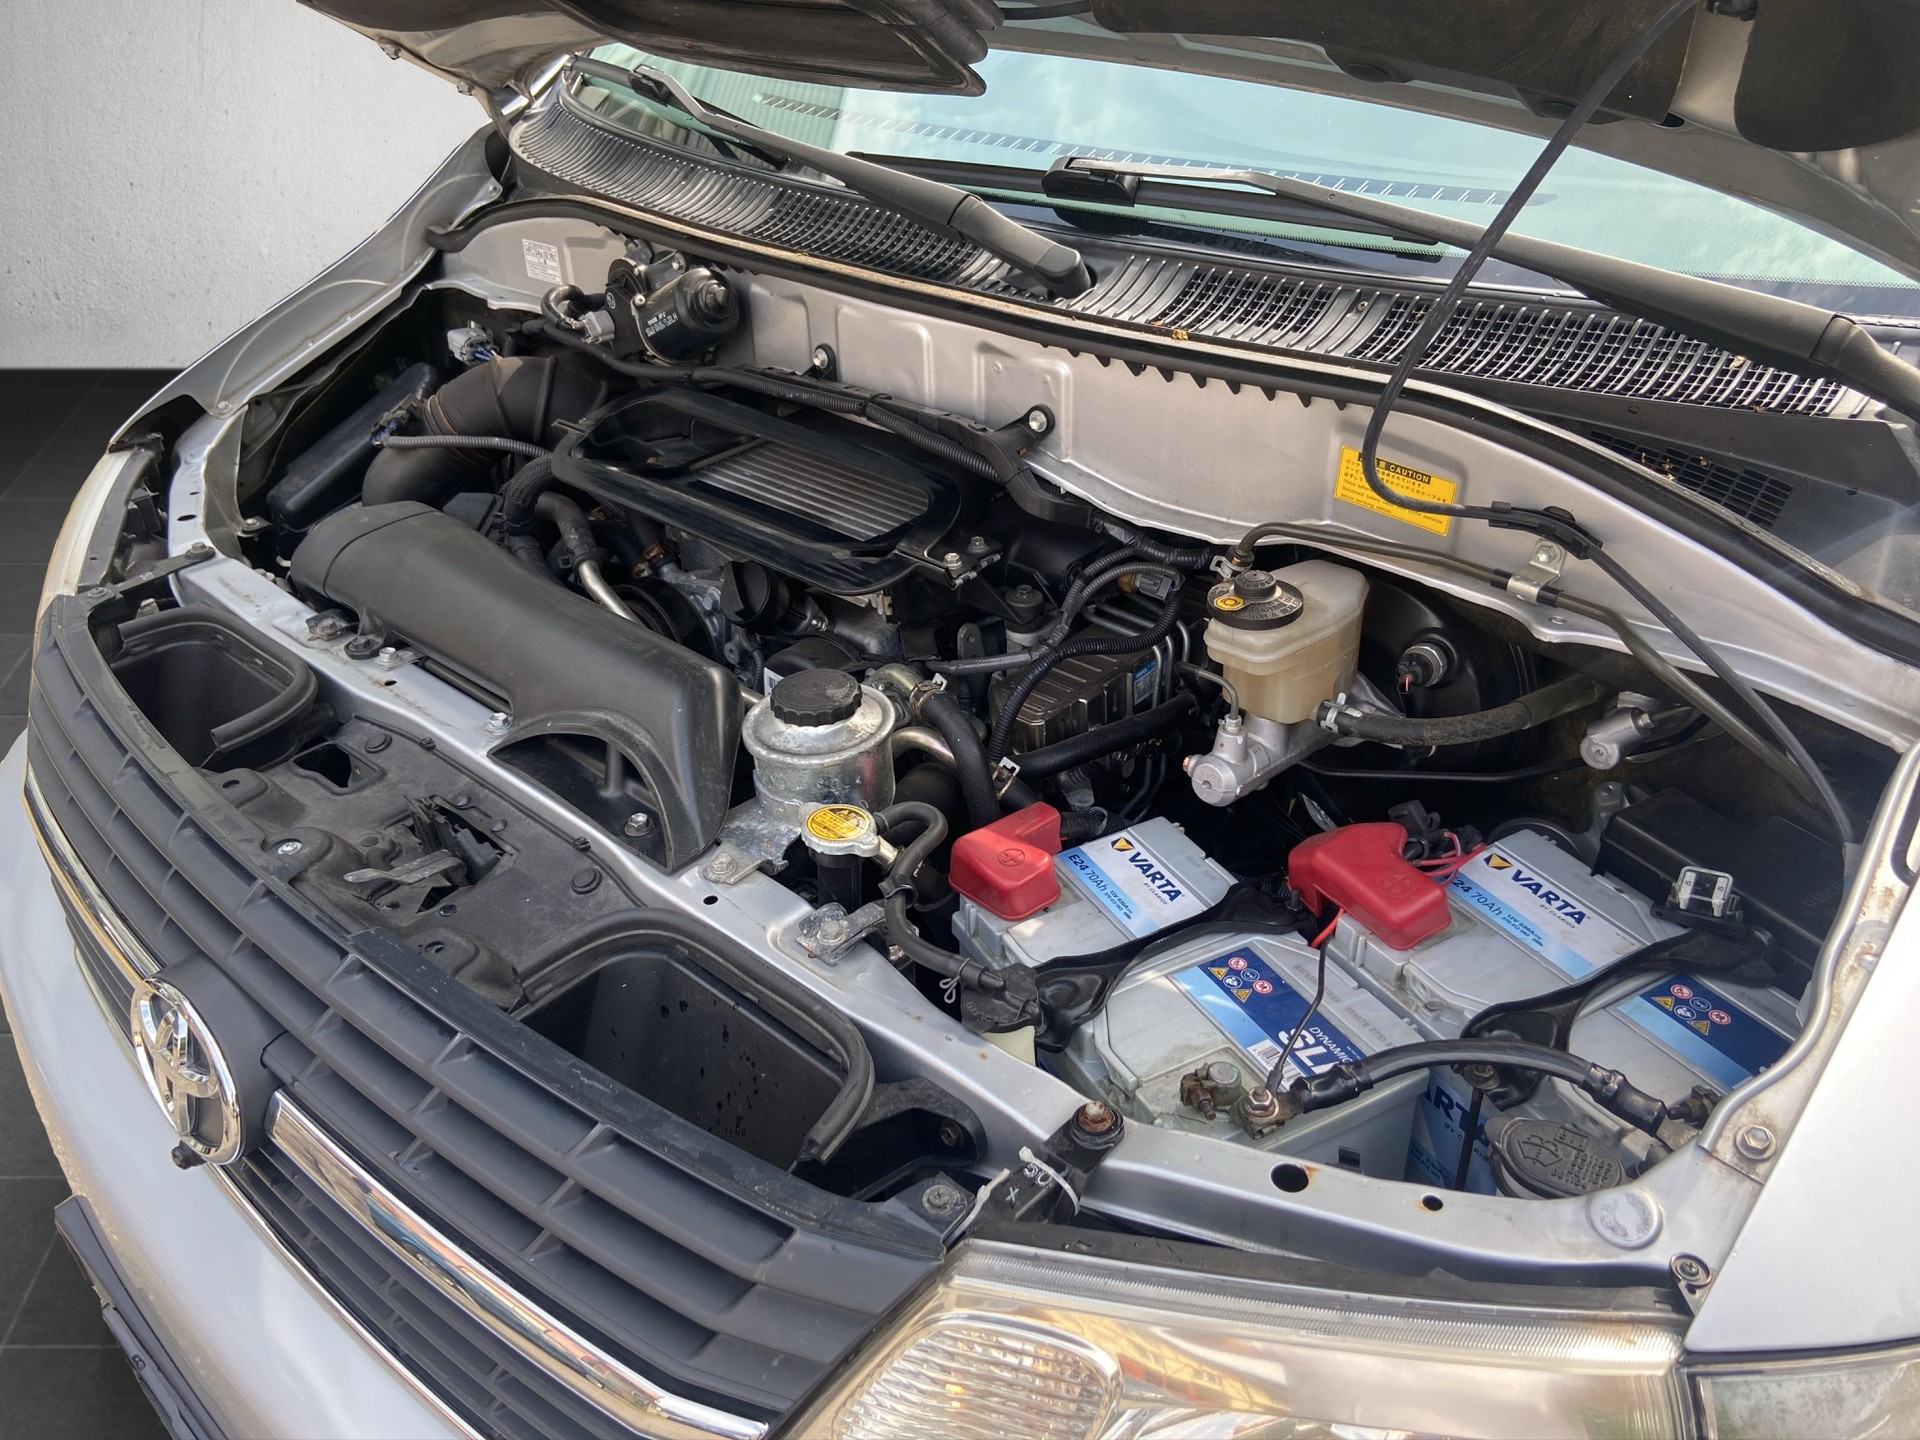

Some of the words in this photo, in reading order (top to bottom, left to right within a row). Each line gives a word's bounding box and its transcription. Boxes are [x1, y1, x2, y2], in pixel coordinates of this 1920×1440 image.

[1390, 464, 1429, 483] CAUTION
[1068, 854, 1090, 872] E24
[1085, 870, 1108, 892] 70Ah
[1128, 851, 1183, 902] VARTA
[1470, 891, 1503, 916] 70Ah
[1511, 869, 1587, 925] VARTA
[1309, 1026, 1353, 1064] DYNAMIC
